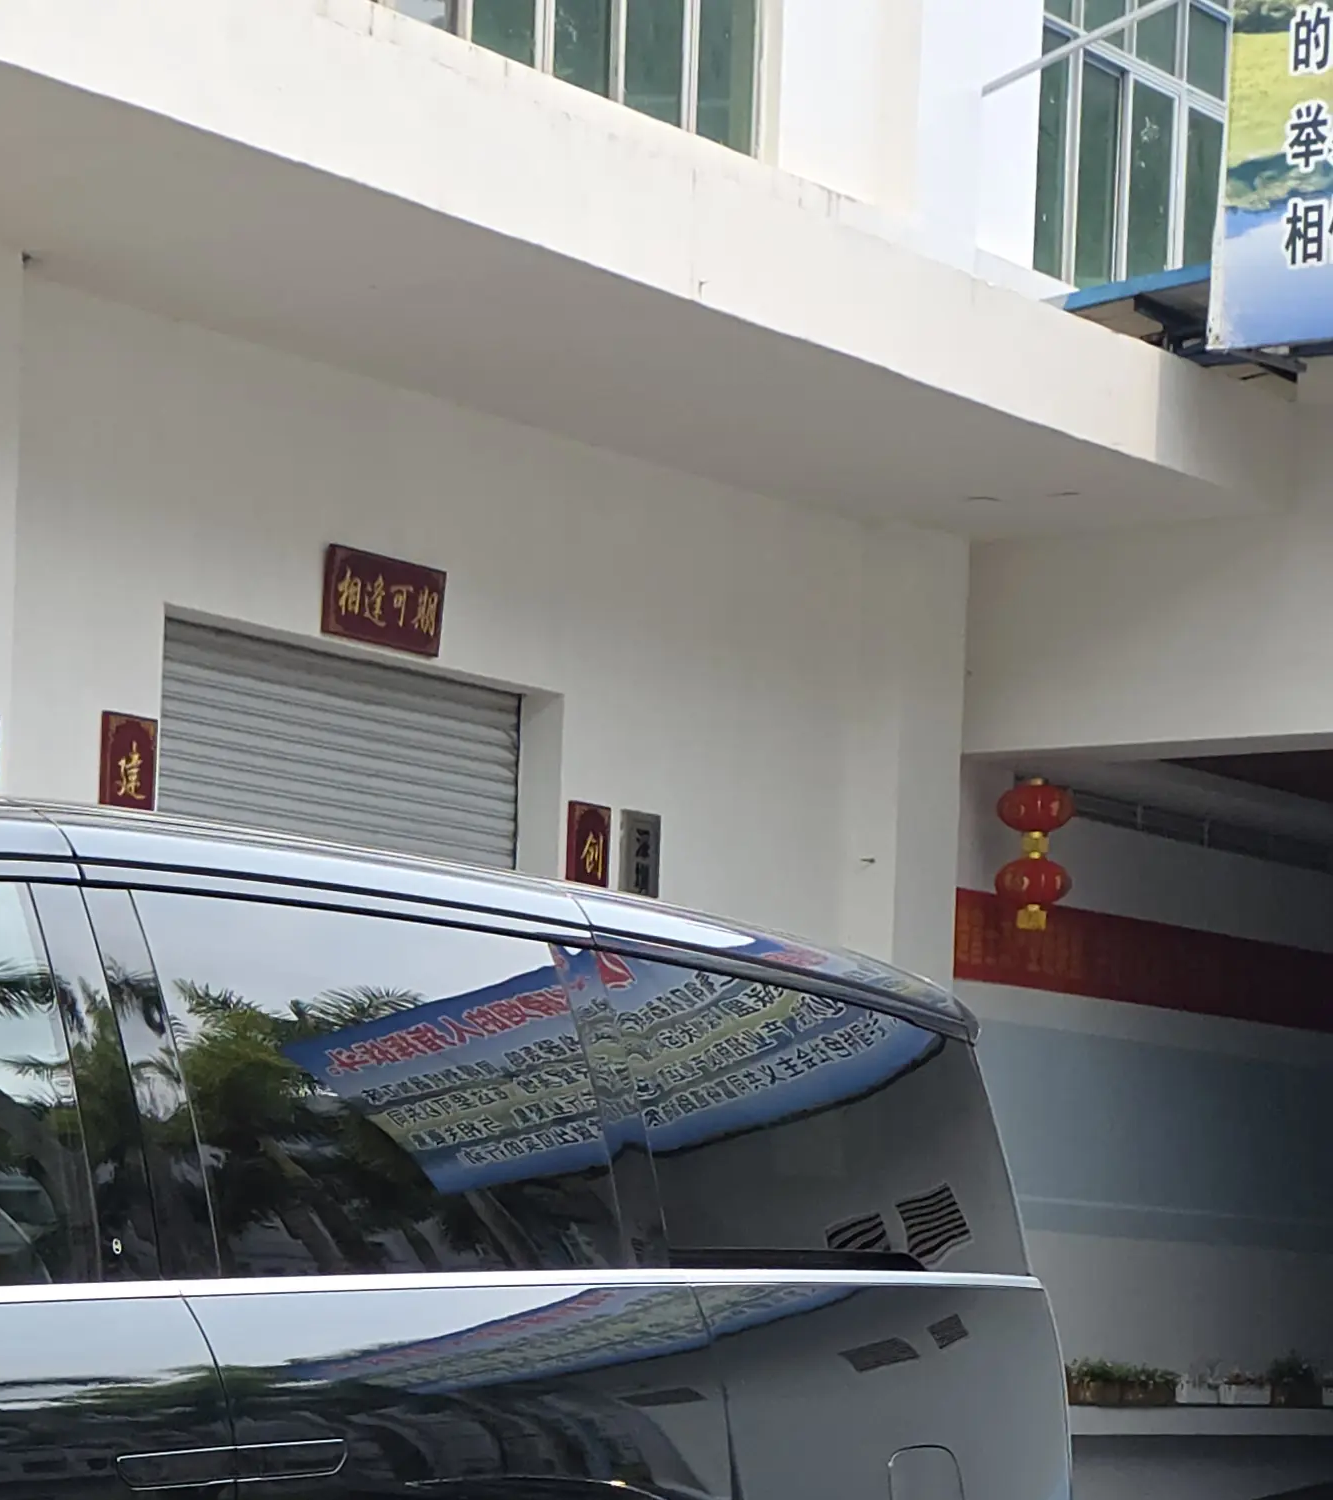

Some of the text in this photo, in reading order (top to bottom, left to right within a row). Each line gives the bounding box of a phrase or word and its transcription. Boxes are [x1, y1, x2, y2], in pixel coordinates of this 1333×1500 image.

[1291, 7, 1331, 71] 的
[1288, 103, 1333, 168] 举
[1285, 202, 1333, 265] 相
[336, 565, 439, 637] 相逢可期
